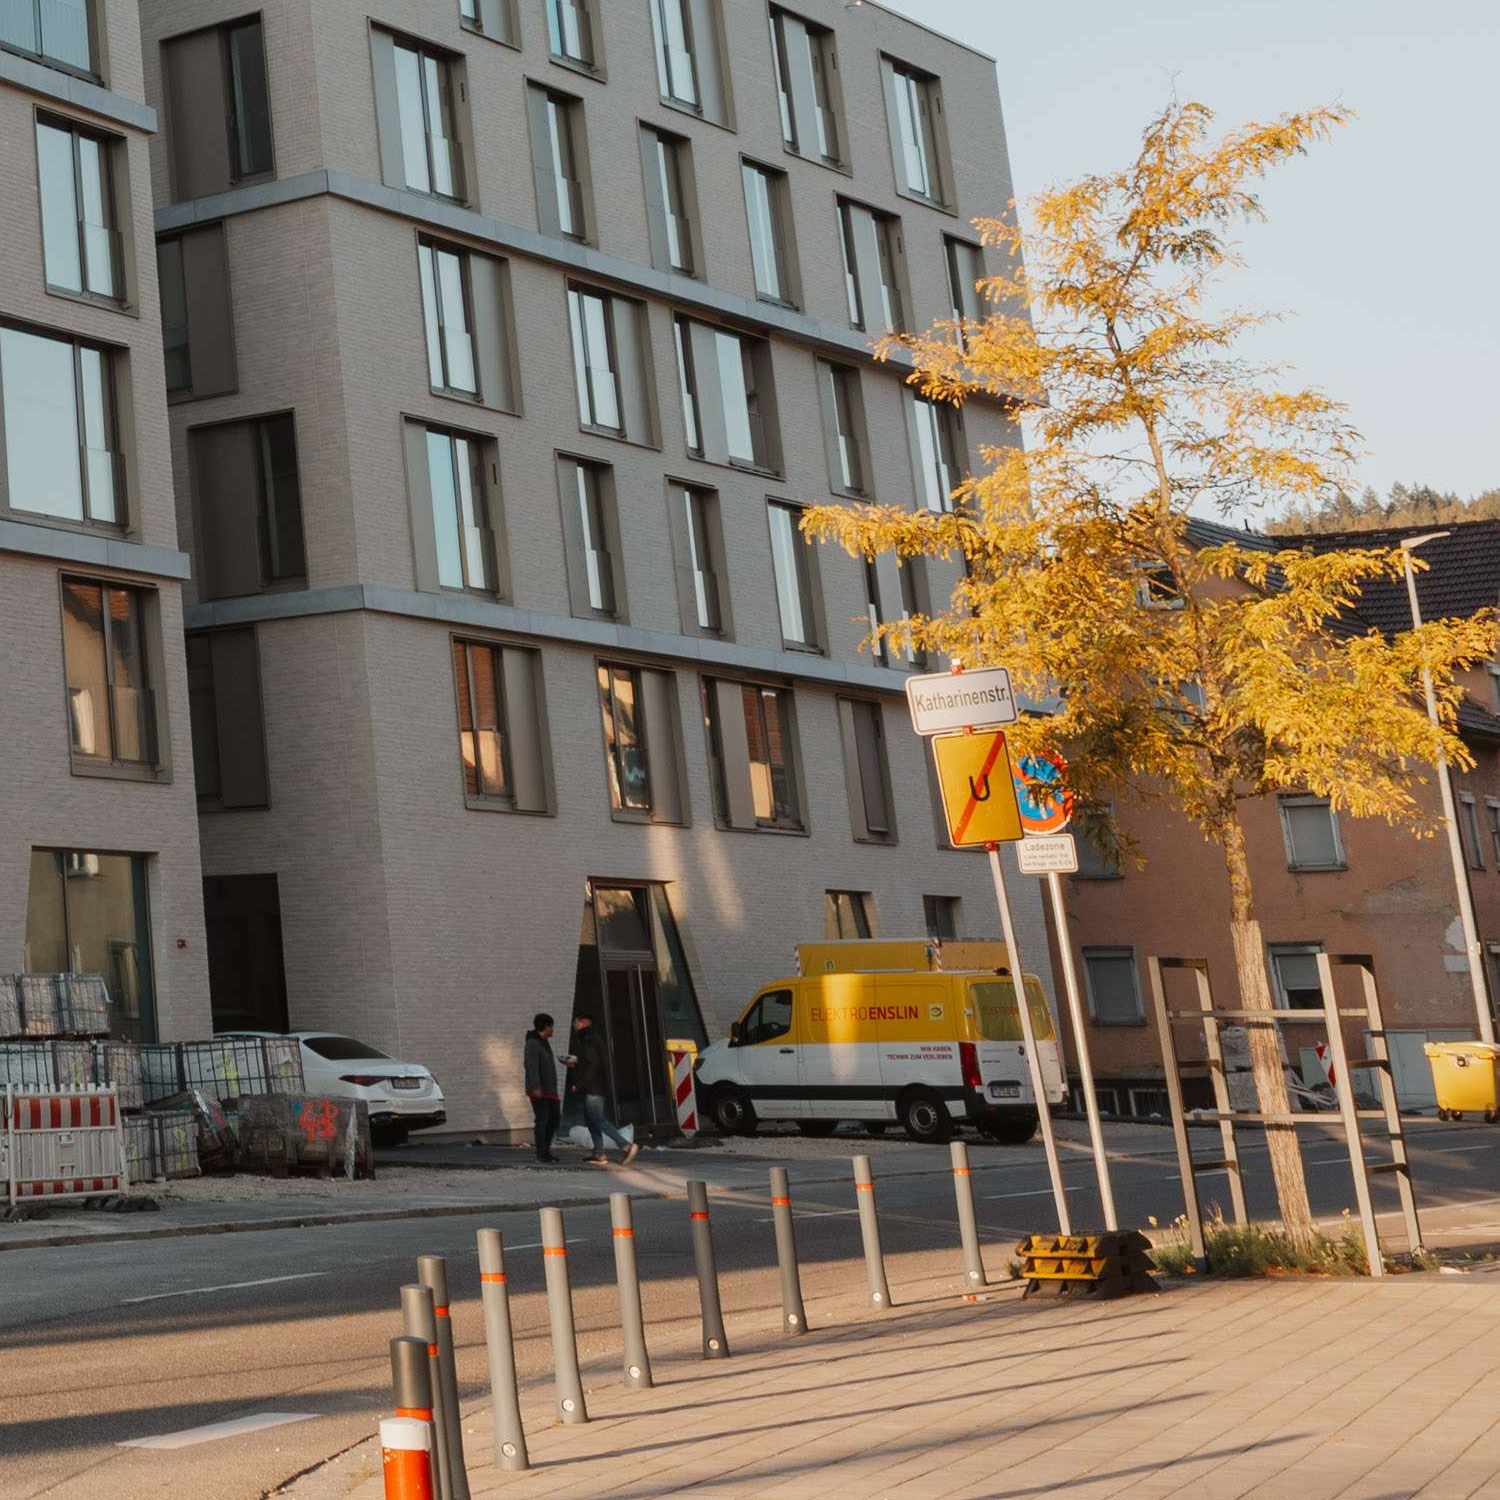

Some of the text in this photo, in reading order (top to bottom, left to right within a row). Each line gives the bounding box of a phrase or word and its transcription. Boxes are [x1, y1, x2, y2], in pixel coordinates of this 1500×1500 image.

[914, 685, 1009, 712] Katharinenstr.
[969, 773, 990, 801] U
[811, 1005, 919, 1022] ELEKTROENSLIN
